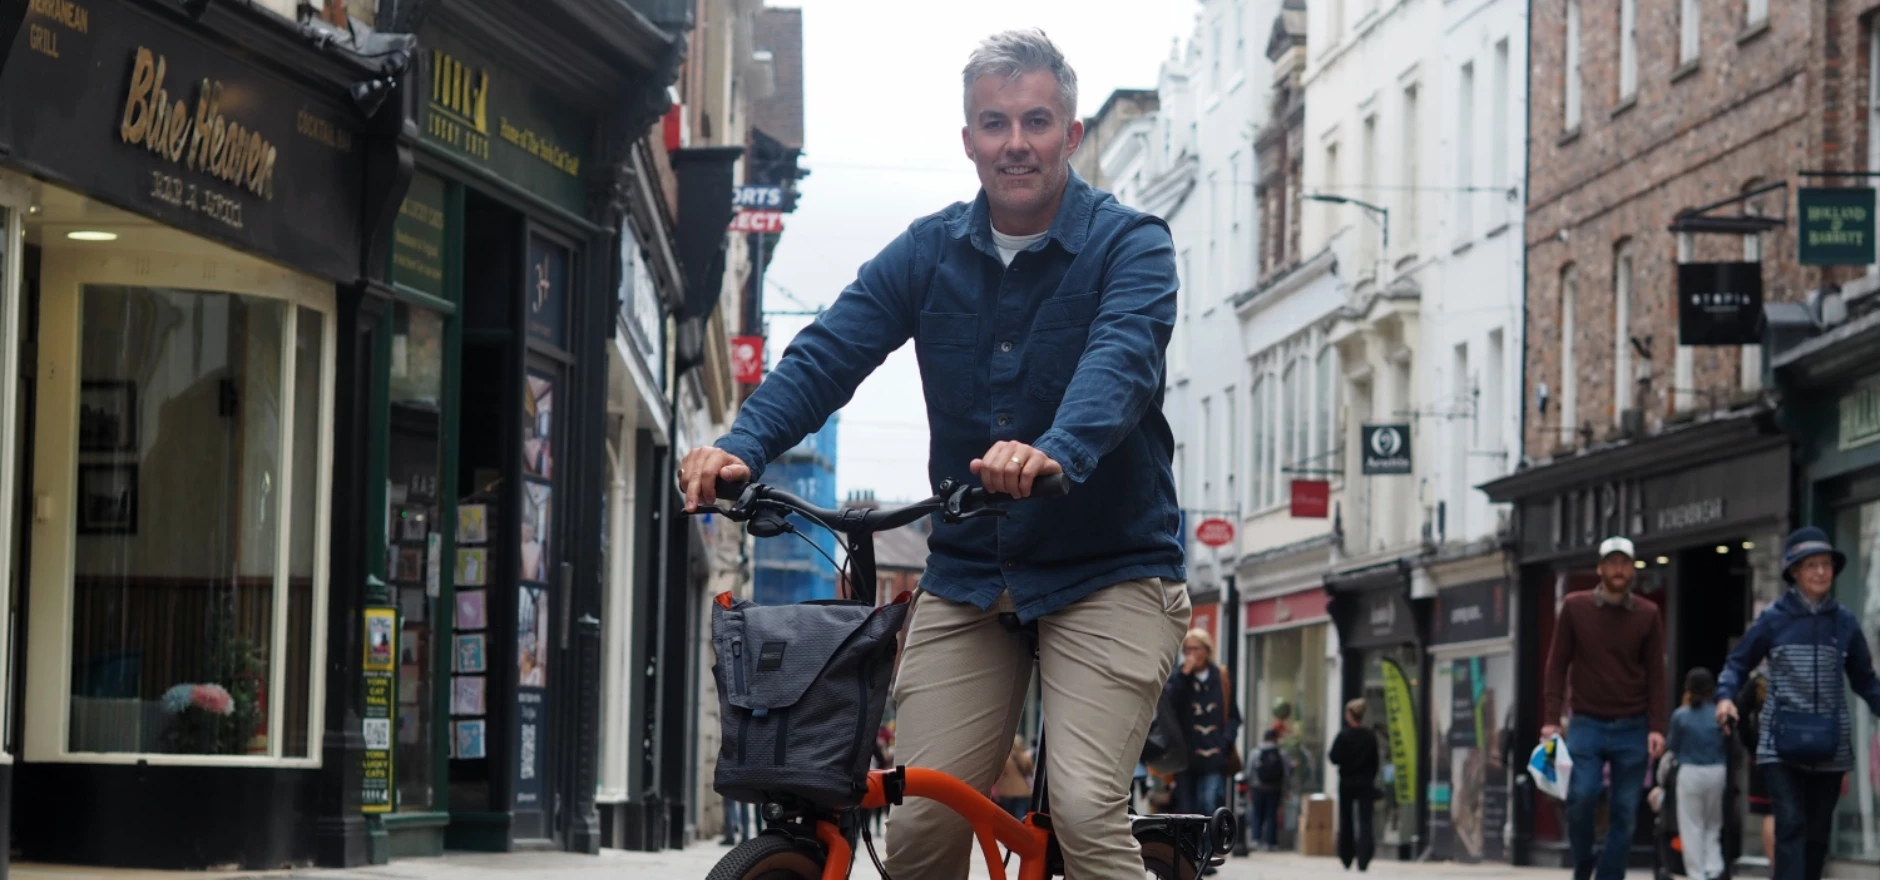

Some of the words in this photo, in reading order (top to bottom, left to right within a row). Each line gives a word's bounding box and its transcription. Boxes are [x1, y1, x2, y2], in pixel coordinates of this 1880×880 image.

[30, 23, 59, 58] GRILL
[121, 46, 193, 163] Blue
[187, 77, 276, 200] Heaven
[150, 170, 184, 206] BAR
[1807, 206, 1867, 221] HOLLAND
[1808, 230, 1864, 247] BARRETT
[1691, 293, 1750, 305] UTOPIA
